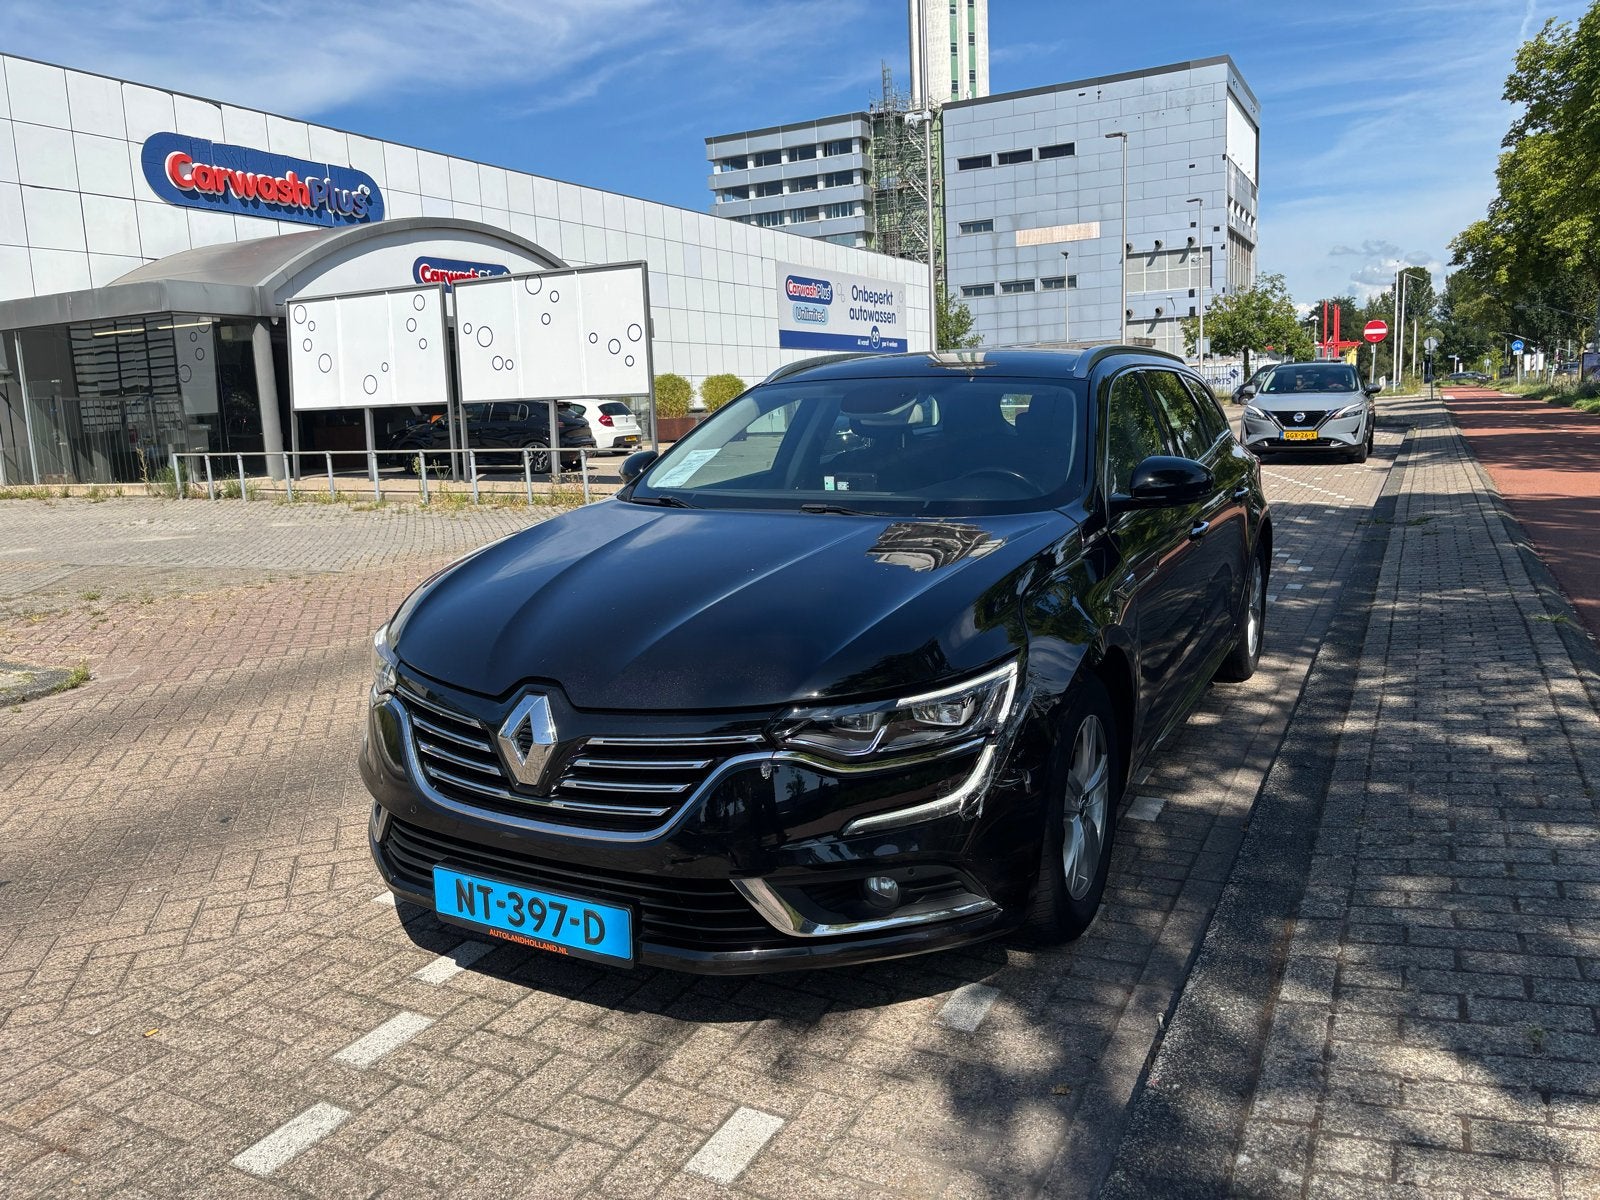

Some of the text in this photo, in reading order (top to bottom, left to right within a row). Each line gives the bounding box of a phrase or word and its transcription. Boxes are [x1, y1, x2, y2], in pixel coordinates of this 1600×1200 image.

[164, 150, 369, 219] CarwashPlus
[787, 279, 831, 300] CarwashPlus
[851, 284, 893, 308] Onbeperkt
[795, 306, 826, 323] Unlimited
[849, 305, 897, 325] autowassen
[455, 878, 606, 946] NT-397-D
[489, 928, 569, 955] AUTOLANDHOLLAND.NL
